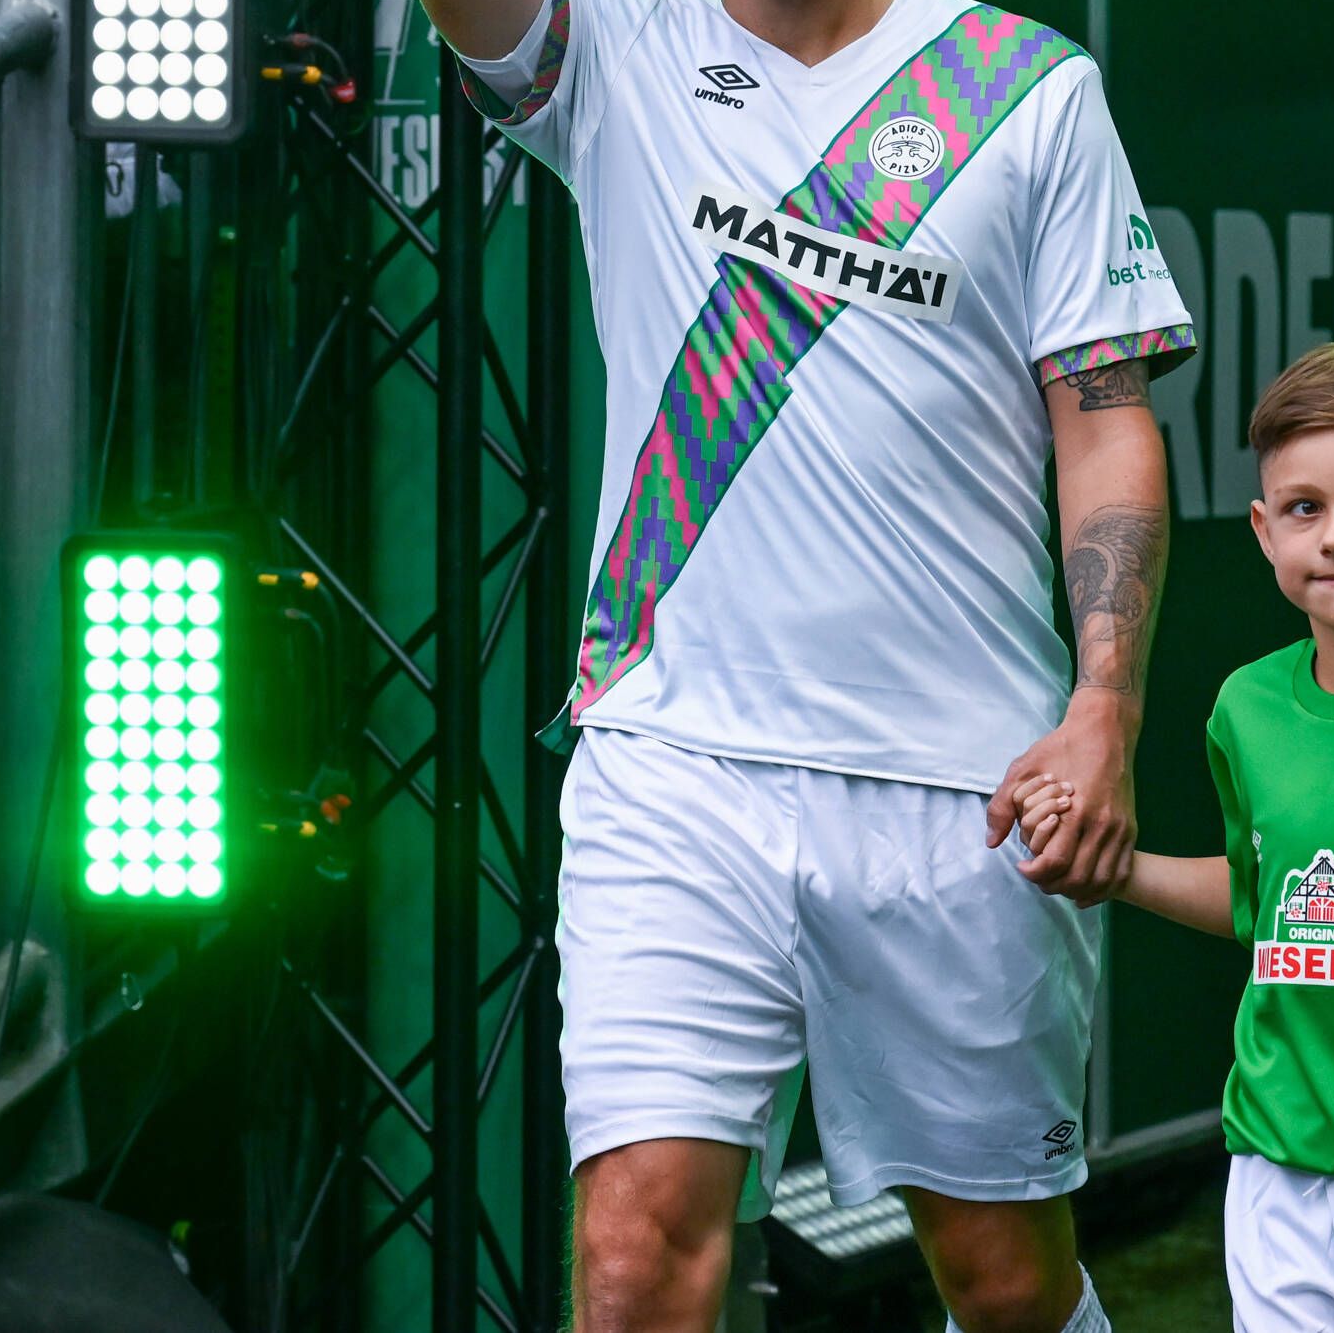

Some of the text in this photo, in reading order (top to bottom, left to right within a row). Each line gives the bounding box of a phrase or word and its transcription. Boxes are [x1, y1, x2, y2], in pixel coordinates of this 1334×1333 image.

[694, 87, 745, 110] umbro
[891, 124, 926, 136] ADIOS
[889, 162, 919, 174] PIZA
[692, 194, 948, 308] MATTHÄI
